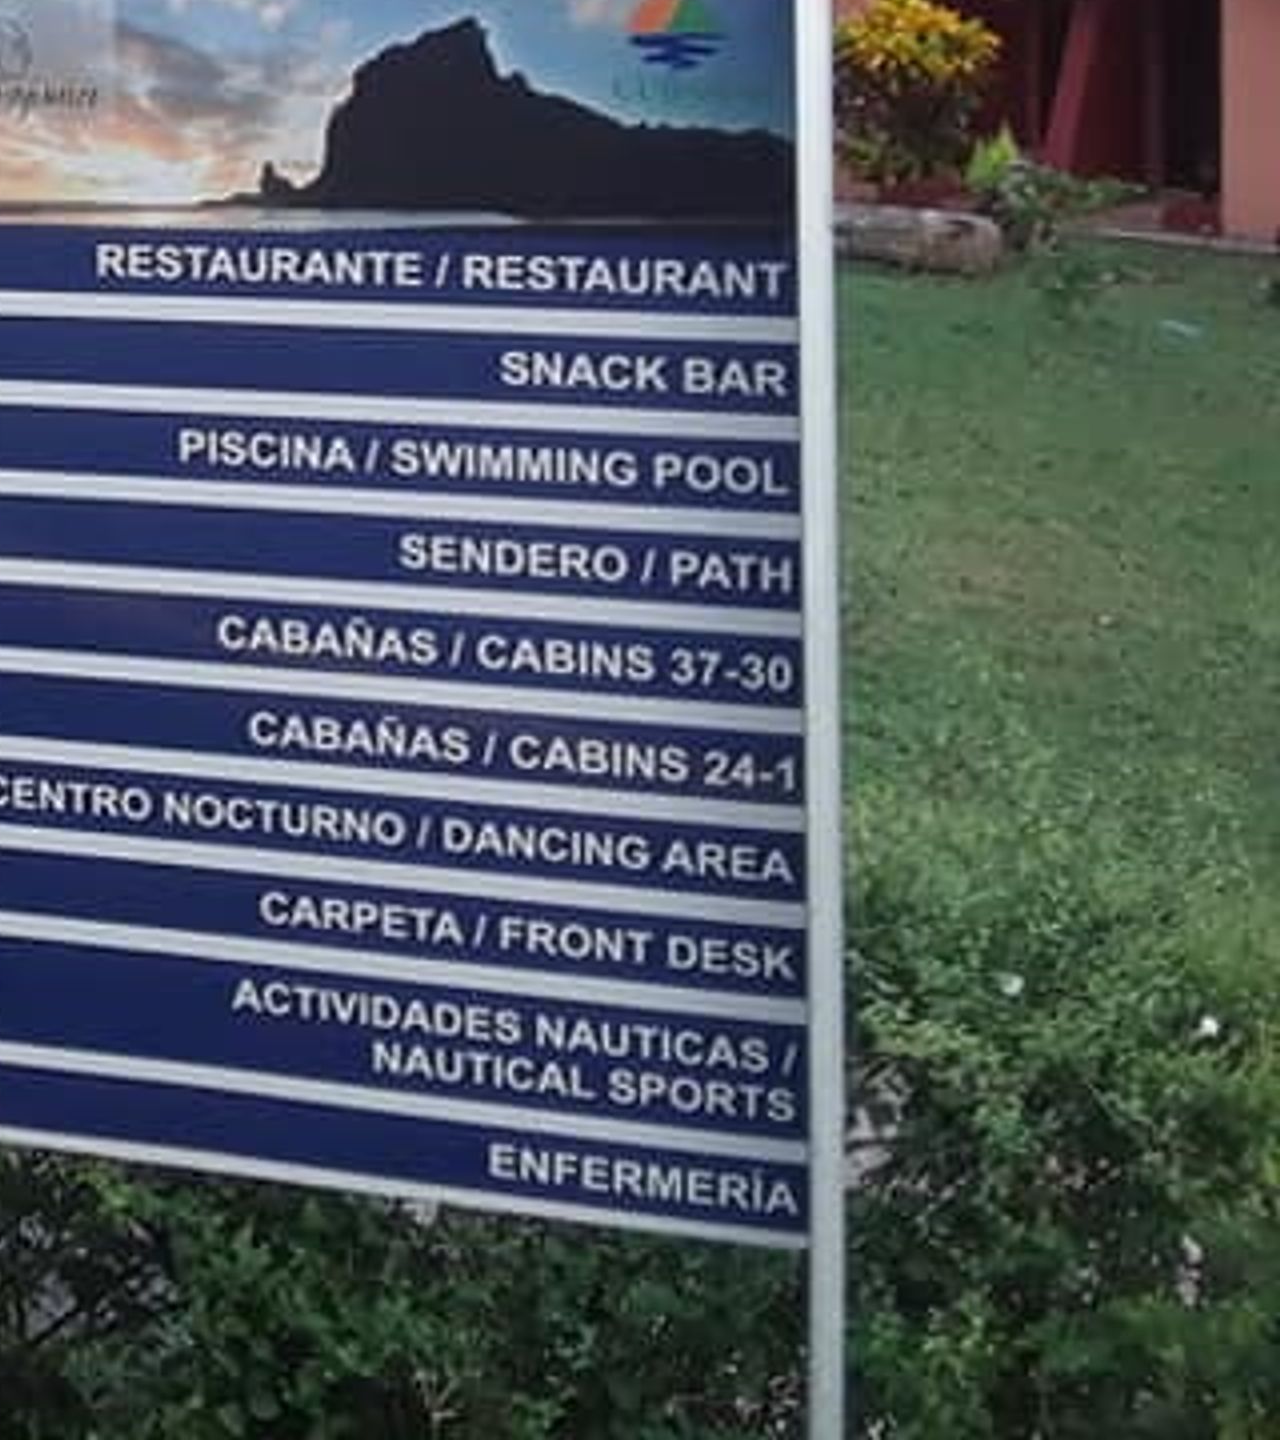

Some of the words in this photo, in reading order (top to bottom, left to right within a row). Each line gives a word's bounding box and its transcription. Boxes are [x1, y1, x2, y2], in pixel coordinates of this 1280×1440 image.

[96, 243, 423, 286] RESTAURANTE
[434, 253, 450, 288] /
[462, 254, 785, 297] RESTAURANT
[500, 351, 668, 391] SNACK
[683, 357, 786, 396] BAR
[179, 429, 355, 472] PISCINA
[364, 438, 381, 473] /
[391, 439, 638, 487] SWIMMING
[653, 452, 789, 495] POOL
[400, 533, 629, 582] SENDERO
[640, 548, 657, 584] /
[670, 550, 791, 593] PATH
[217, 615, 438, 665] CABAÑAS
[449, 632, 466, 667] /
[476, 634, 656, 681] CABINS
[670, 647, 793, 691] 37-30
[247, 713, 470, 764] CABAÑAS
[482, 731, 498, 766] /
[509, 734, 689, 782] CABINS
[703, 750, 794, 791] 24-1
[165, 793, 407, 846] NOCTURNO
[416, 815, 432, 849] /
[443, 817, 650, 870] DANCING
[661, 839, 793, 882] AREA
[259, 891, 464, 943] CARPETA
[472, 913, 488, 947] /
[499, 915, 654, 964] FRONT
[667, 934, 793, 979] DESK
[232, 979, 522, 1041] ACTIVIDADES
[535, 1015, 769, 1072] NAUTICAS
[781, 1043, 798, 1076] /
[372, 1044, 596, 1098] NAUTICAL
[609, 1069, 796, 1122] SPORTS
[489, 1144, 799, 1215] ENFERMERÍA
